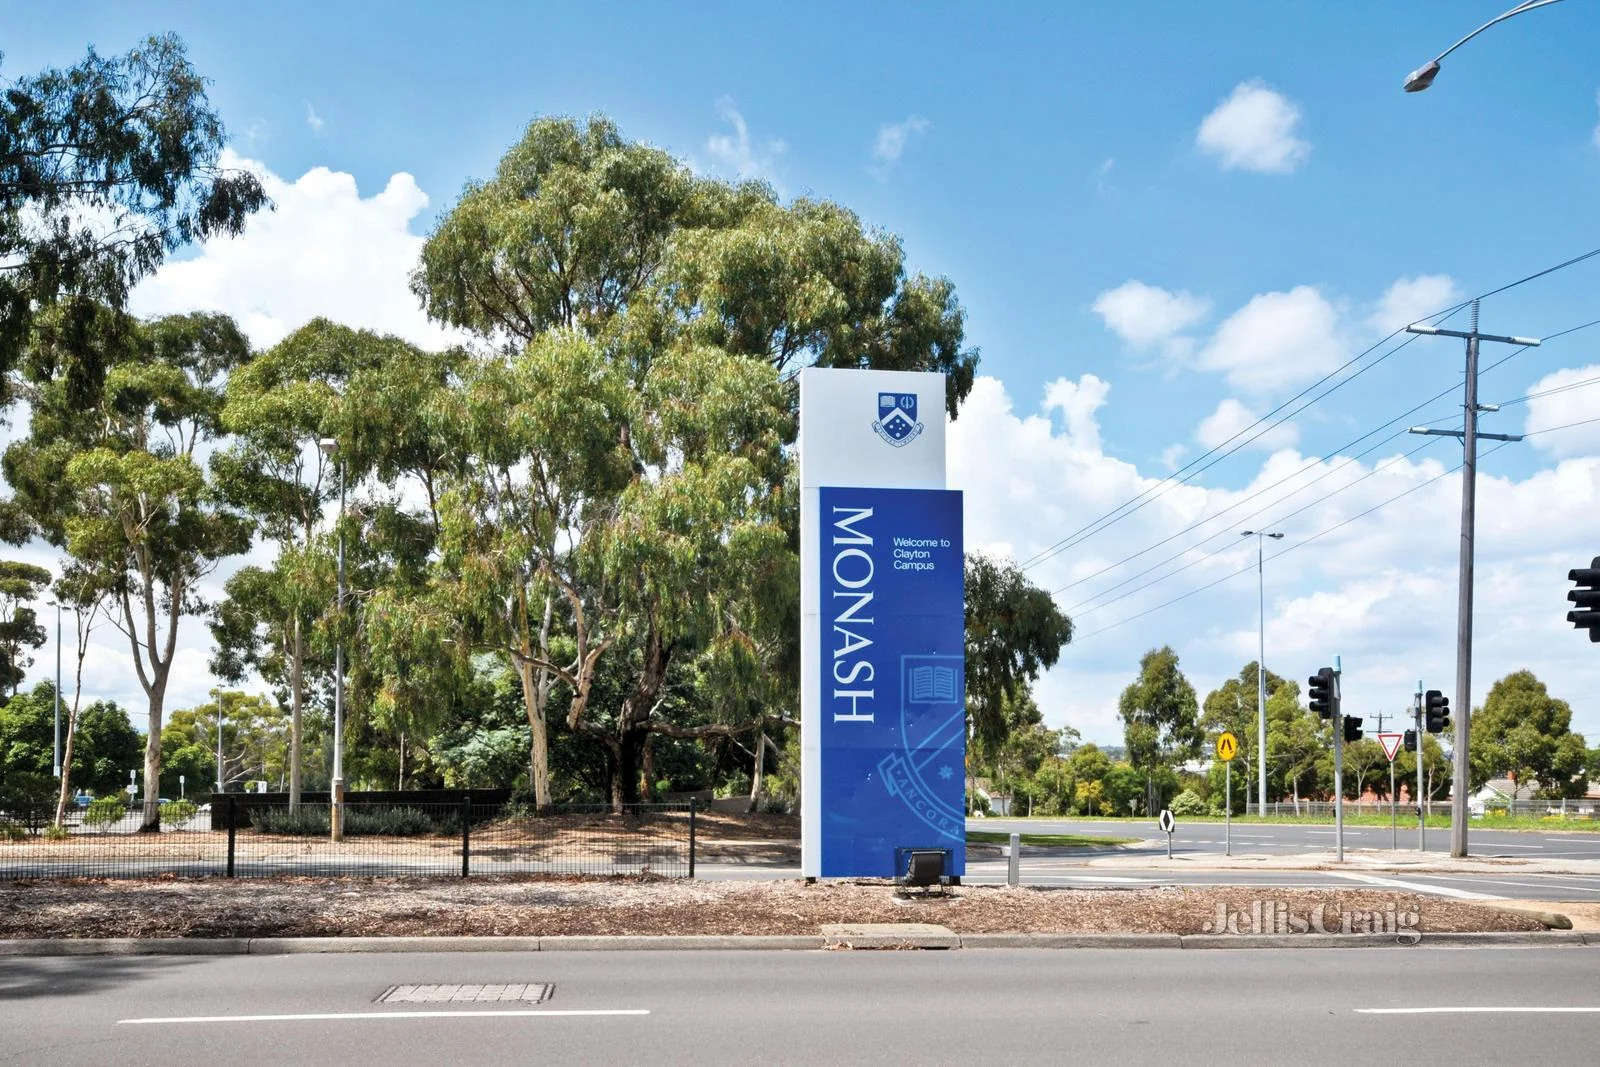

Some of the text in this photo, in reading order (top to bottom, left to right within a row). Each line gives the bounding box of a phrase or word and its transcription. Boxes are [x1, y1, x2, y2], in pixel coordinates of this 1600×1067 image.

[893, 537, 951, 548] Welcome to
[893, 548, 931, 561] Clayton
[893, 560, 935, 572] Campus
[833, 506, 875, 723] MONASH
[898, 778, 960, 836] ANCORA
